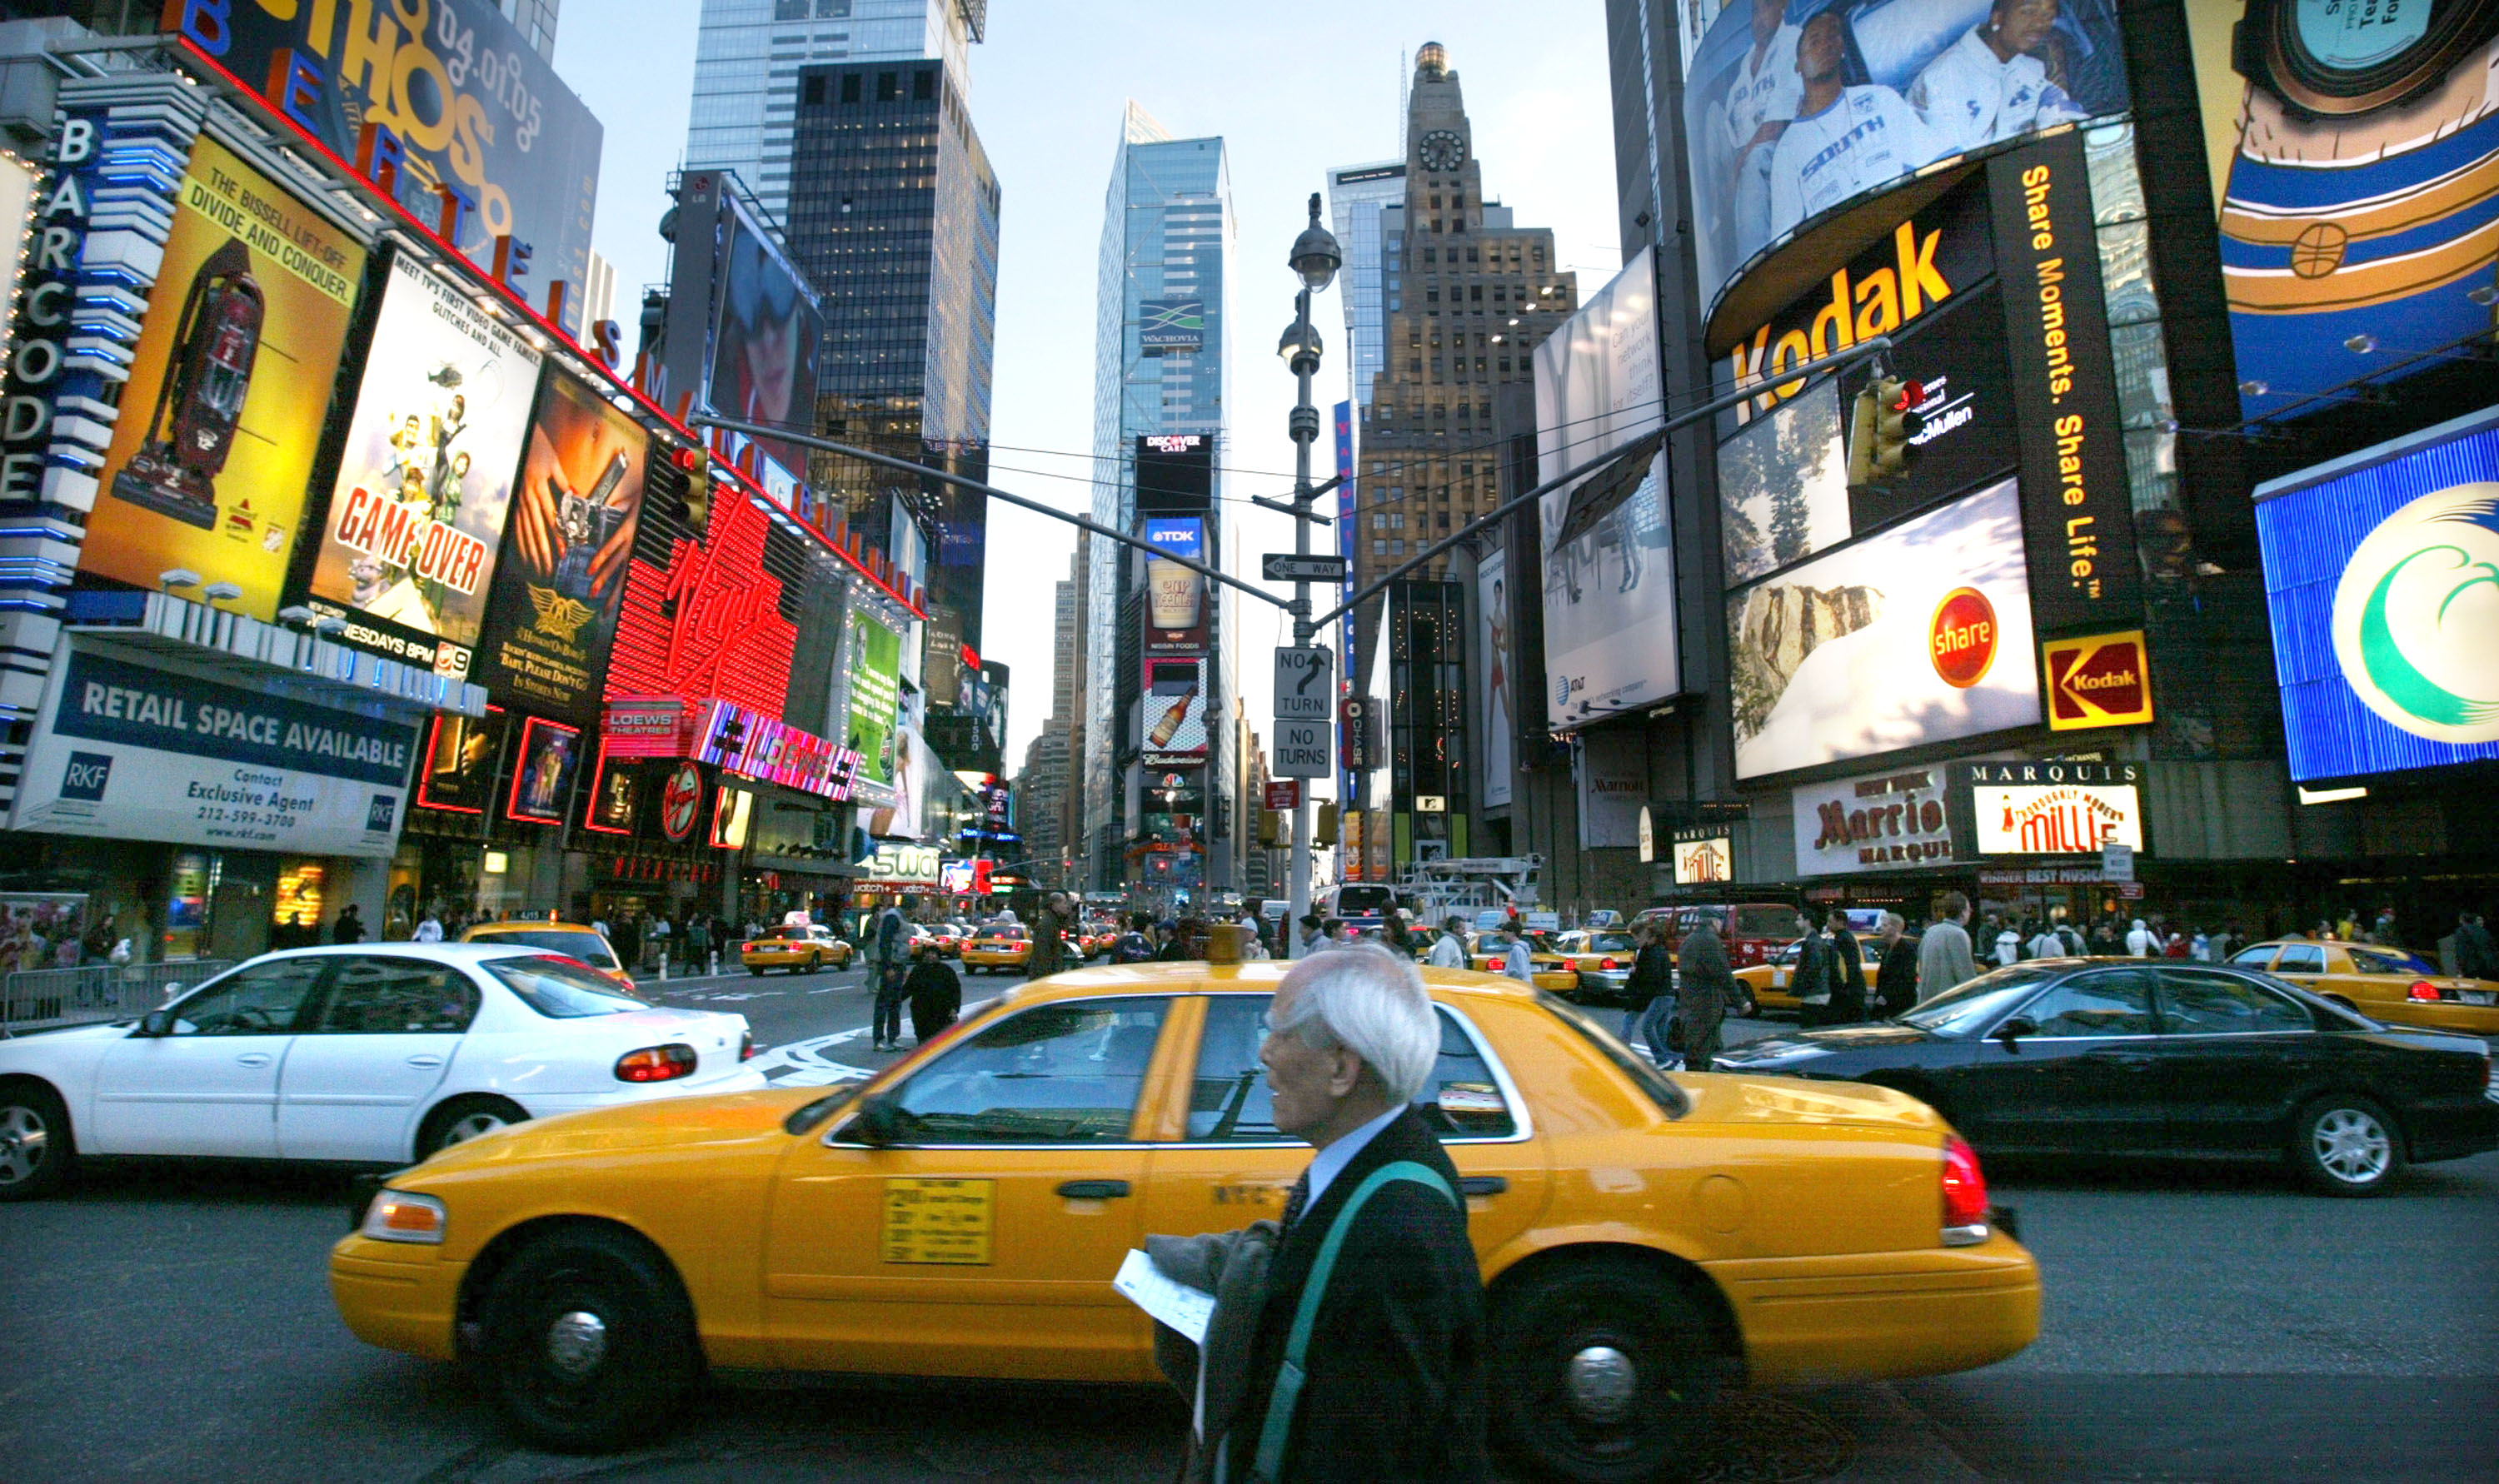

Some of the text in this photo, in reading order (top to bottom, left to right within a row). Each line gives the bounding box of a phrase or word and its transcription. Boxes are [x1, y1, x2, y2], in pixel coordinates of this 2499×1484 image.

[1801, 115, 1885, 182] SOUTH
[211, 167, 348, 270] THE BISSELL LIFT-OFF
[2021, 165, 2053, 251] Share
[191, 183, 348, 301] DIVIDE AND CONQUER.
[2, 119, 92, 500] BARCODE
[394, 256, 541, 367] MEET TV'S FIRST VIDEO GAME FAMILY.
[432, 301, 470, 335] GLITCHES
[471, 330, 487, 347] AND
[1732, 220, 1953, 427] Kodak
[1142, 334, 1200, 343] WACHOVIA
[1613, 310, 1650, 348] Can your
[2036, 257, 2076, 405] Moments.
[1617, 330, 1652, 367] network
[1629, 352, 1654, 381] think
[1626, 372, 1654, 405] itself?
[1146, 435, 1200, 447] DISCOVER
[2054, 414, 2085, 505] Share
[337, 486, 485, 595] GAME OVER
[1162, 530, 1195, 542] TDK
[1273, 563, 1336, 574] ONE WAY
[1935, 620, 1990, 656] share
[406, 642, 436, 664] 8PM
[455, 650, 469, 672] 9
[1280, 653, 1305, 669] NO
[1569, 675, 1586, 693] AT&T
[2073, 670, 2136, 691] Kodak
[609, 714, 672, 725] LOEWS
[1282, 697, 1324, 712] TURN
[82, 681, 405, 769] RETAIL SPACE AVAILABLE
[609, 727, 671, 735] THEATRES
[1289, 729, 1314, 745] NO
[1278, 749, 1327, 765] TURNS
[1352, 718, 1363, 766] CHASE
[1142, 753, 1206, 765] Budweiser
[1971, 765, 2137, 782] MARQUIS
[66, 762, 107, 789] RKF
[233, 769, 283, 788] Contact
[187, 780, 315, 814] Exclusive Agent
[2014, 789, 2125, 823] THOROUGHLY MODERN
[197, 805, 296, 828] 212-599-3700
[2025, 869, 2058, 883] BEST
